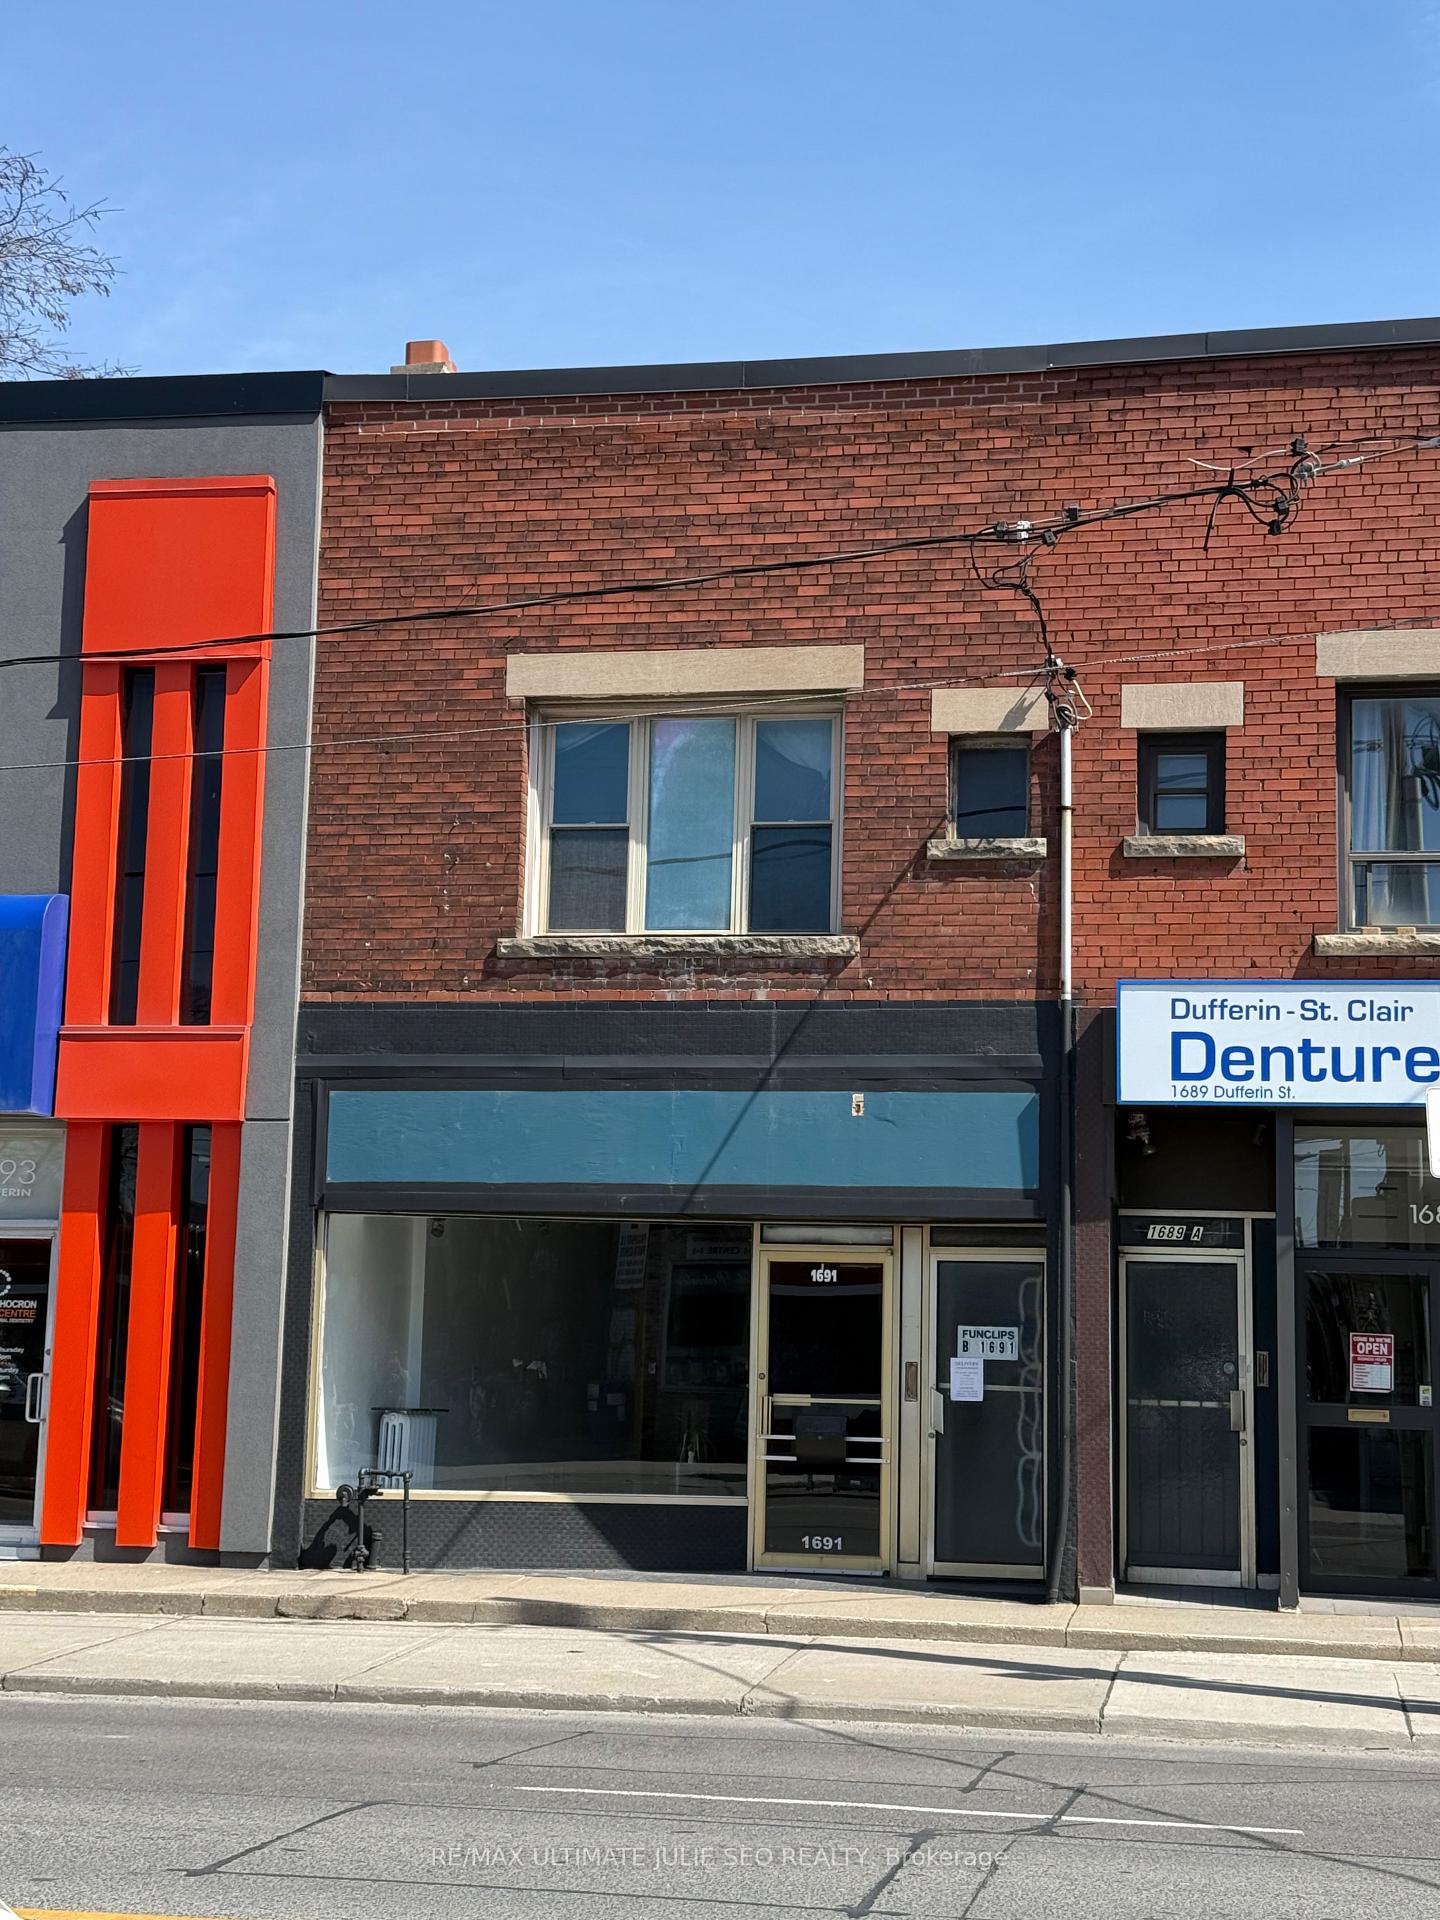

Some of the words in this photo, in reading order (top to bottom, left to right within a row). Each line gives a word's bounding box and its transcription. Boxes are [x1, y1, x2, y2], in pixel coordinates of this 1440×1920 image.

[1347, 998, 1414, 1022] Clair
[1171, 1031, 1440, 1083] Denture
[1171, 1085, 1208, 1099] 1689
[1214, 1085, 1272, 1099] Dufferin
[1278, 1085, 1296, 1099] St.
[0, 1188, 31, 1197] ERIN
[1150, 1226, 1185, 1240] 1689
[1191, 1227, 1201, 1240] A
[810, 1269, 837, 1283] 1691
[962, 1329, 1015, 1340] FUNCLIPS
[962, 1340, 969, 1352] B
[981, 1341, 1014, 1354] 1691
[1356, 1342, 1388, 1355] OPEN
[802, 1535, 842, 1550] 1691
